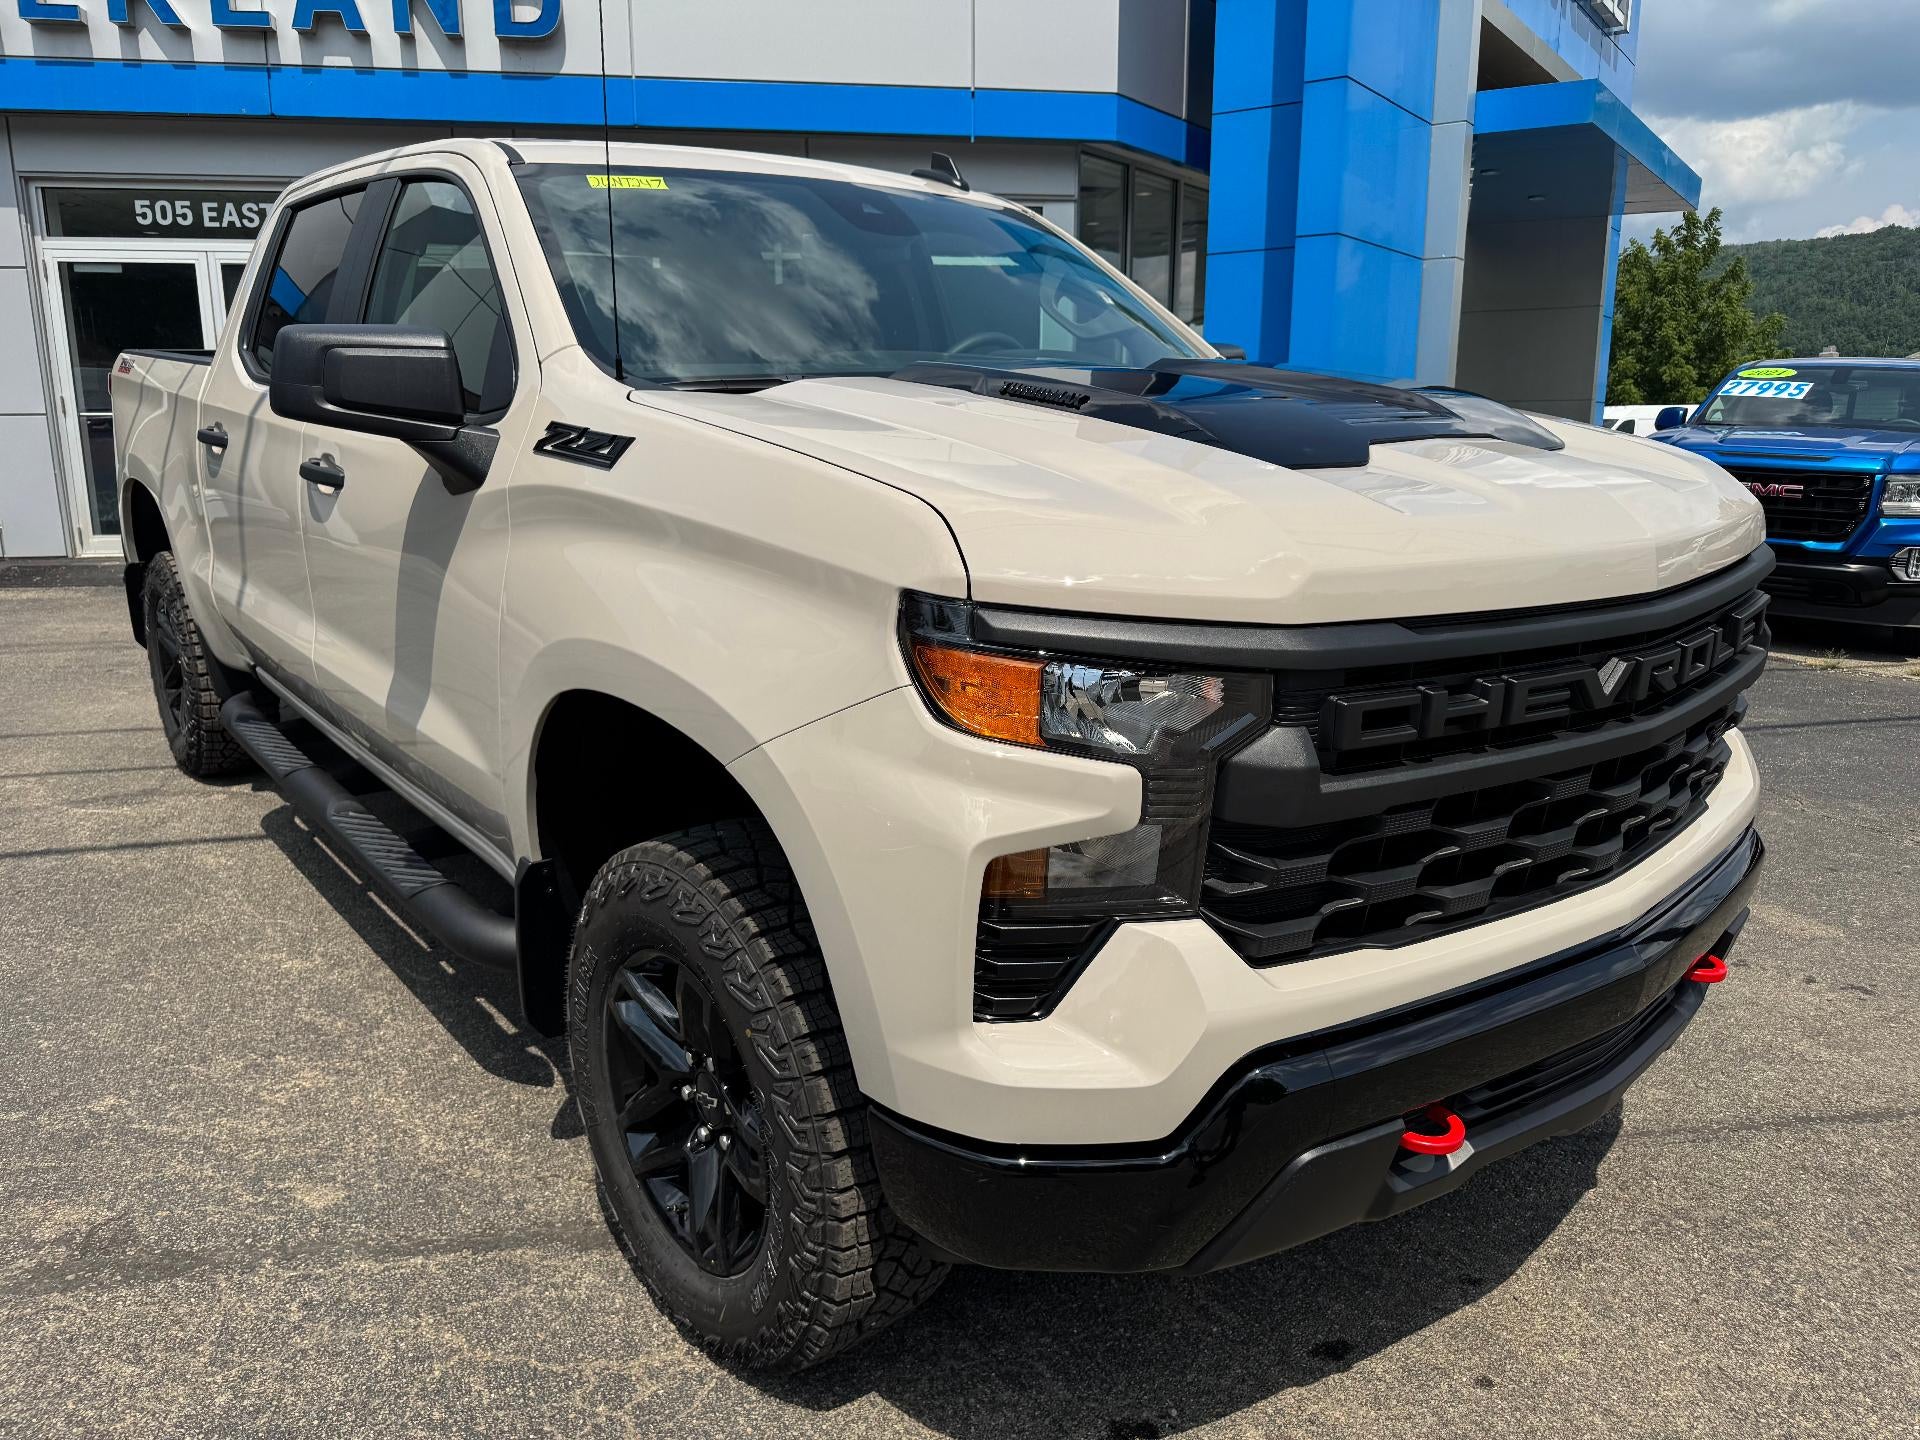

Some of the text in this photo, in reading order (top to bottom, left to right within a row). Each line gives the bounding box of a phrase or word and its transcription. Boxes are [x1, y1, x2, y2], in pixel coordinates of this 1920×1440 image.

[134, 199, 193, 226] 505
[1720, 381, 1811, 397] 27995
[533, 420, 635, 471] Z71
[1740, 481, 1804, 499] MC
